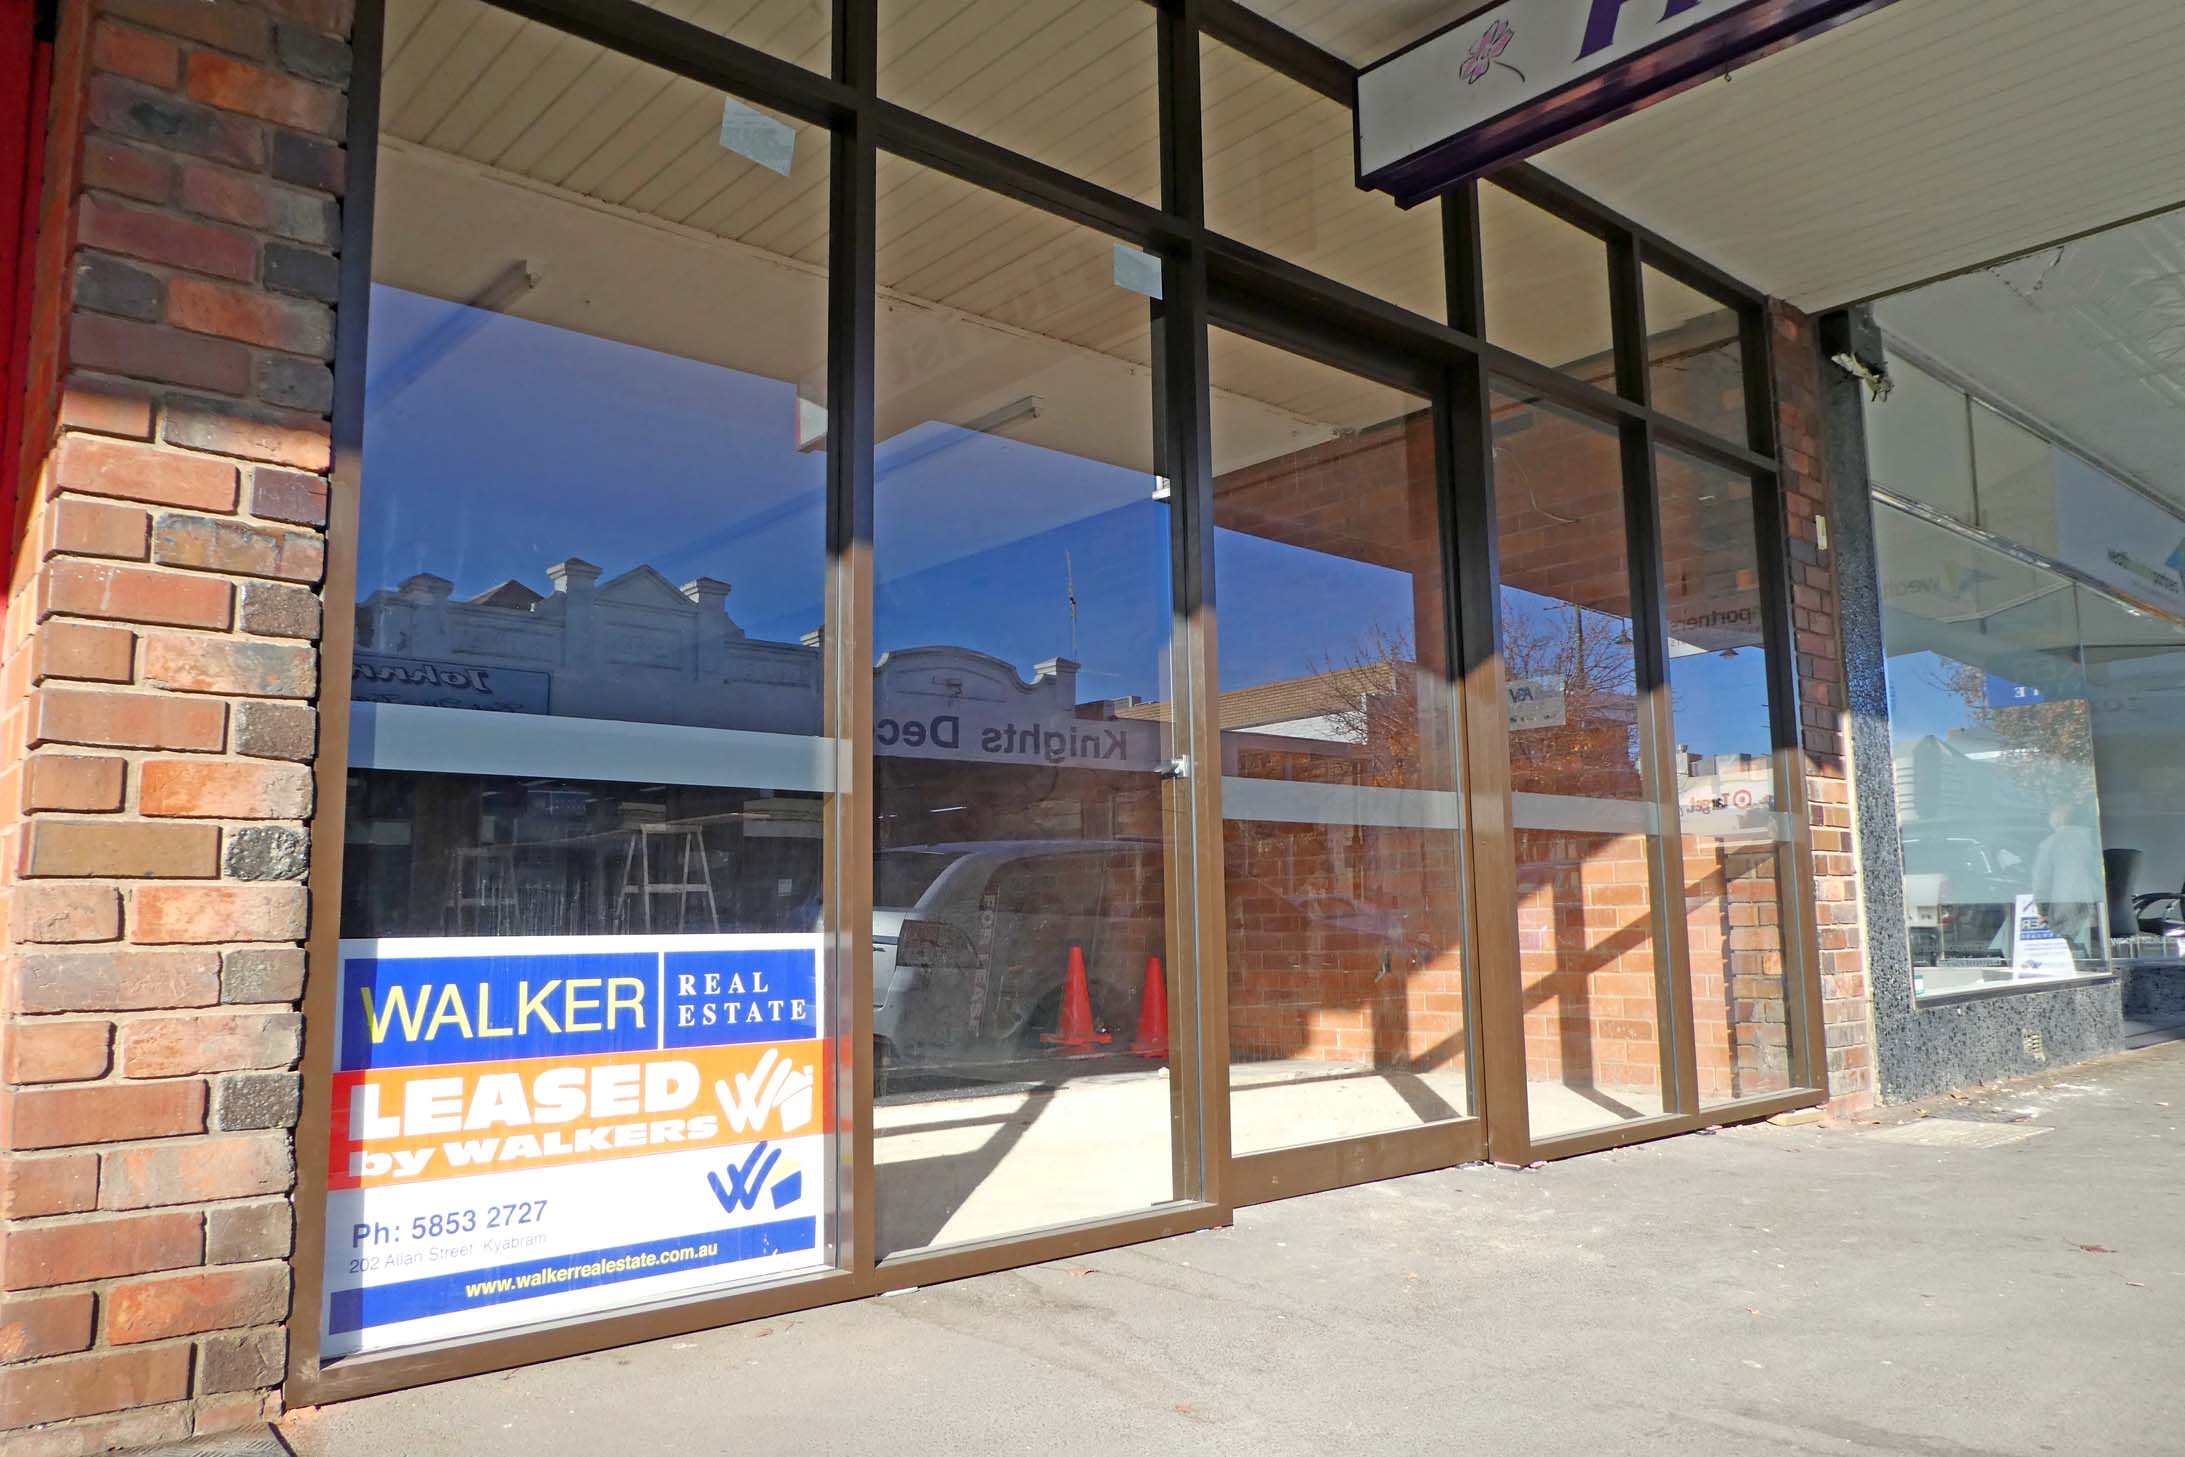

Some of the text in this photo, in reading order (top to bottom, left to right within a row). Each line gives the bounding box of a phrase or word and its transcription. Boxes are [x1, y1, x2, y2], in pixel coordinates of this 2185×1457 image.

[678, 971, 769, 996] REAL
[361, 979, 646, 1043] WALKER
[678, 999, 807, 1027] ESTATE
[349, 1061, 700, 1141] LEASED
[349, 1115, 719, 1178] by WALKERS
[352, 1200, 548, 1249] Ph: 5853 2727
[349, 1257, 381, 1274] 202
[429, 1243, 474, 1262] Street
[483, 1233, 548, 1254] Kyabram
[465, 1242, 718, 1299] www.walkerrealestate.com.au
